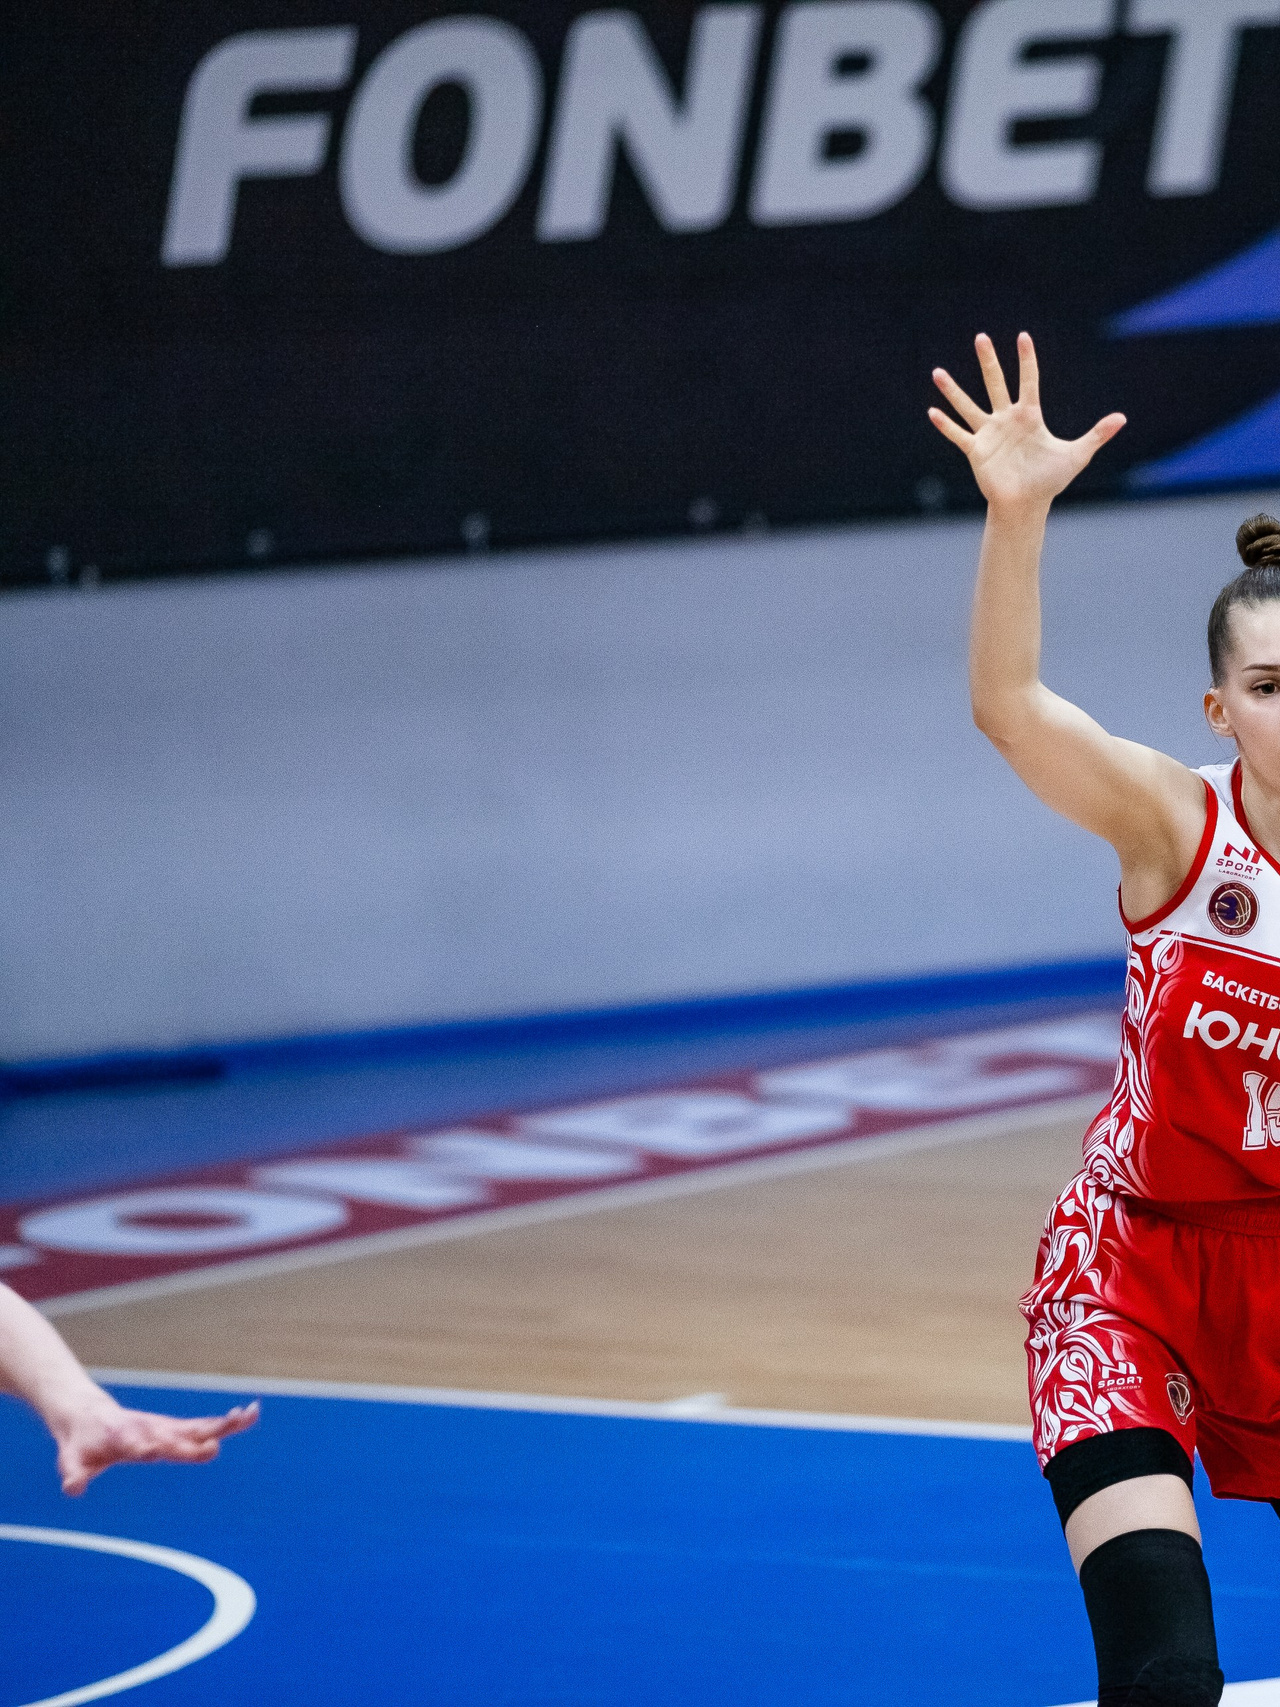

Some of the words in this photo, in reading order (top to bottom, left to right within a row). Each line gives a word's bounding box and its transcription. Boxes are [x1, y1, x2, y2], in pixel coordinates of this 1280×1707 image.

[1215, 857, 1263, 876] SPORT
[1218, 869, 1256, 881] LABORATORY
[0, 1010, 1126, 1270] ONBE
[1098, 1376, 1143, 1389] SPORT
